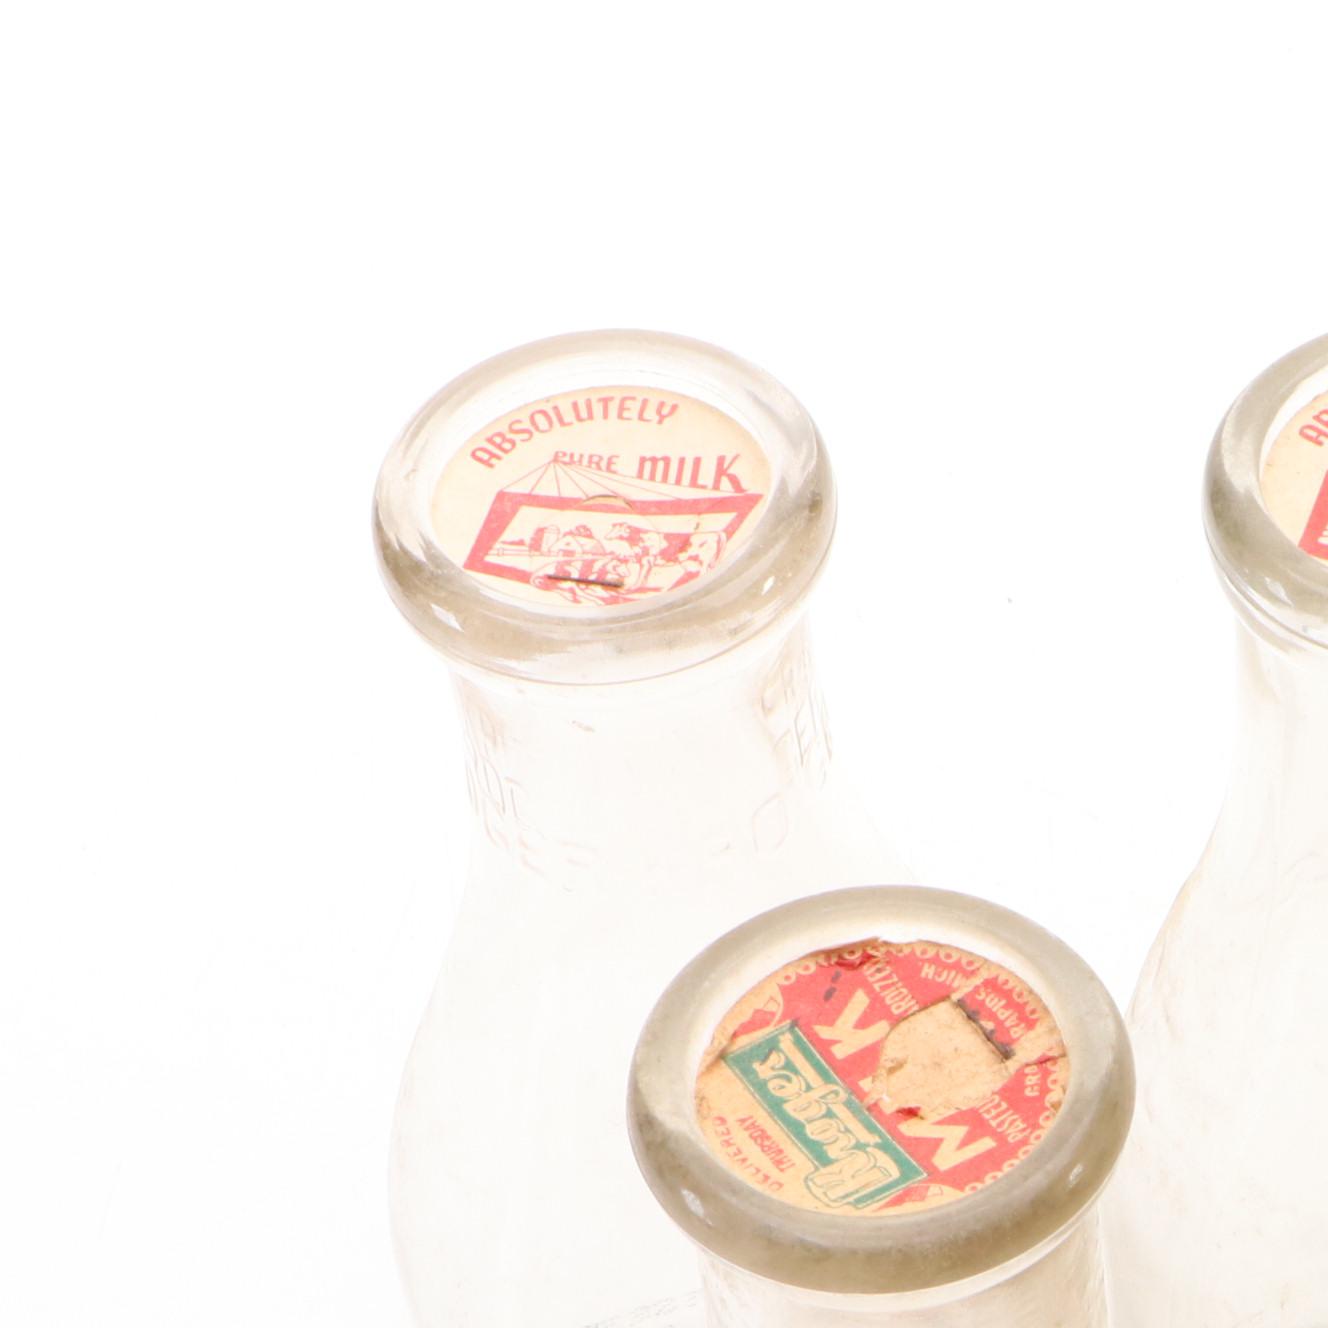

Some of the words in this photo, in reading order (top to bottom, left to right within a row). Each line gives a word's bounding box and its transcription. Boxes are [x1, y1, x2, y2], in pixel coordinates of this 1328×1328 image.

[470, 396, 680, 470] ABSOLUTELY
[553, 450, 621, 474] PURE
[636, 453, 747, 494] MILK
[735, 1115, 796, 1173] THURSDAY
[754, 1046, 898, 1203] Kroger
